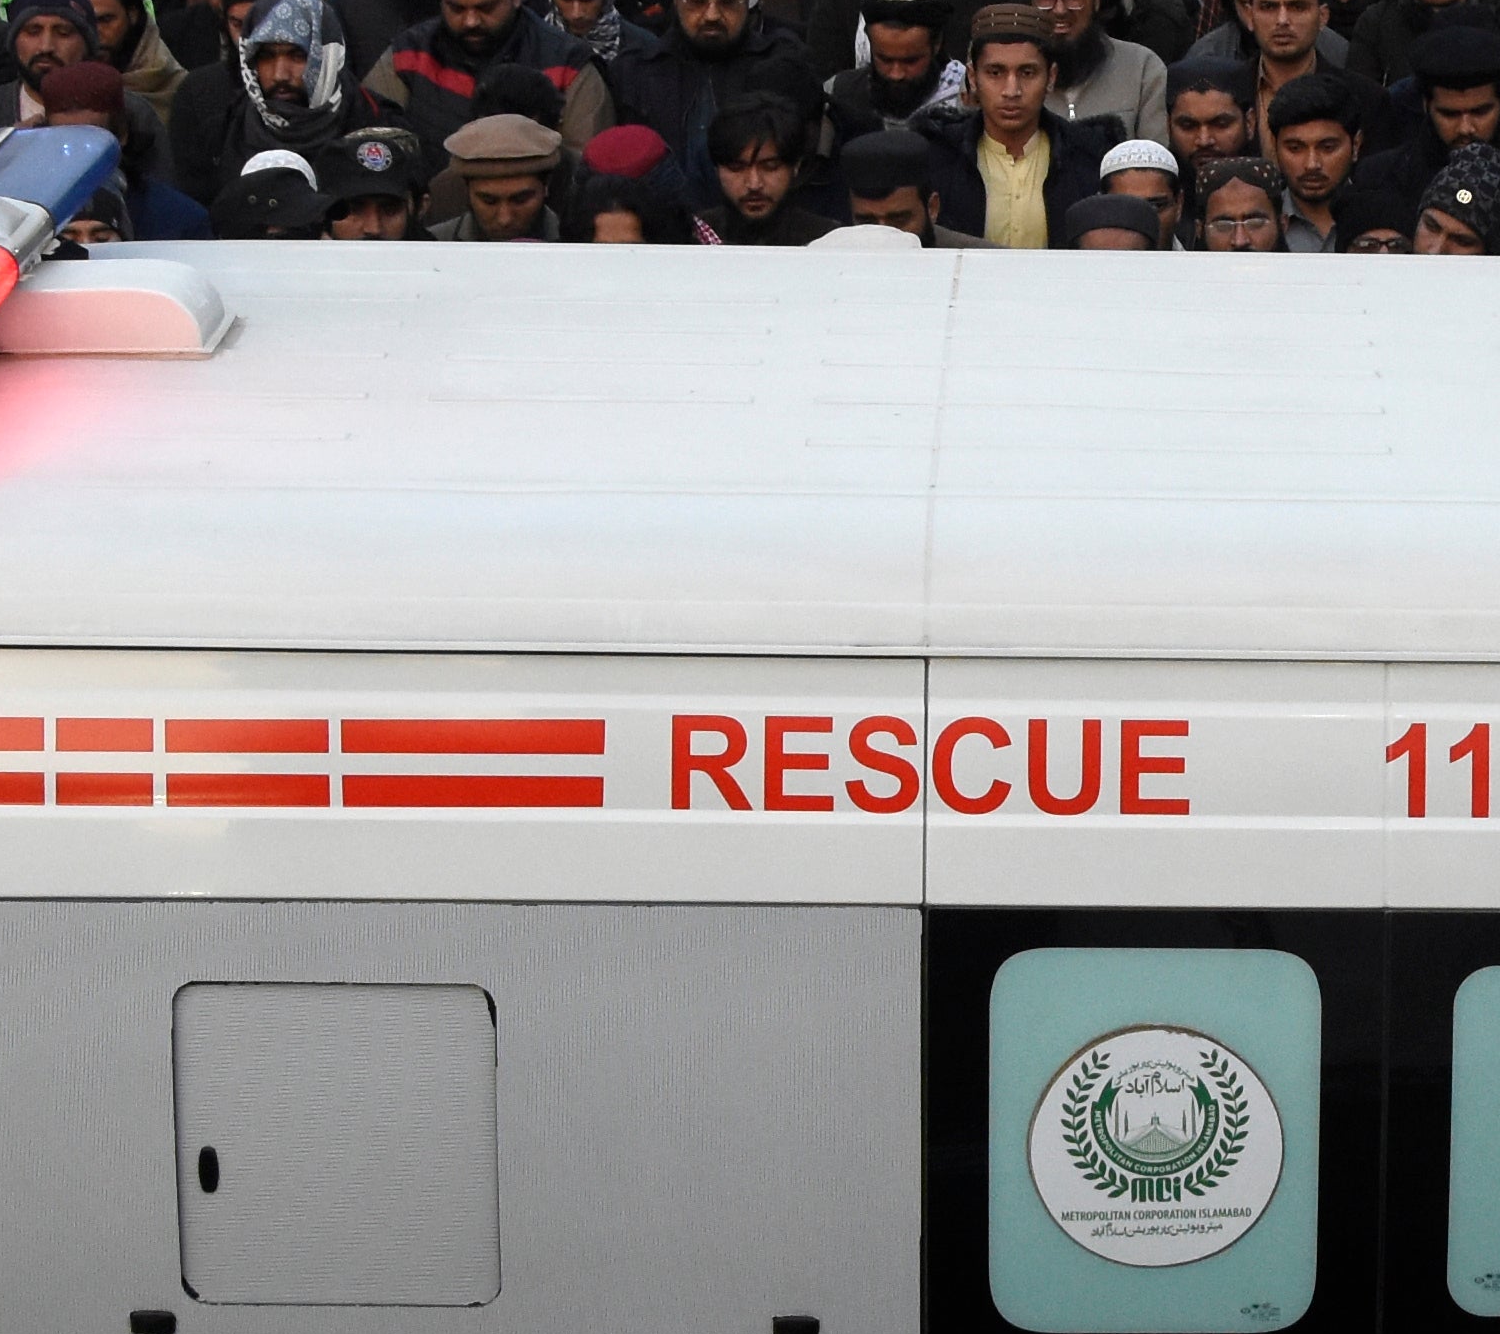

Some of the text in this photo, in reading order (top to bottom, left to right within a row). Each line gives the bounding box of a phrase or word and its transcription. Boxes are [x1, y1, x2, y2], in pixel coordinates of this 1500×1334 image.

[671, 714, 1191, 816] RESCUE
[1133, 1151, 1197, 1174] CORPORATION
[1060, 1207, 1252, 1222] METROPOLITAN CORPORATION ISLAMABAD
